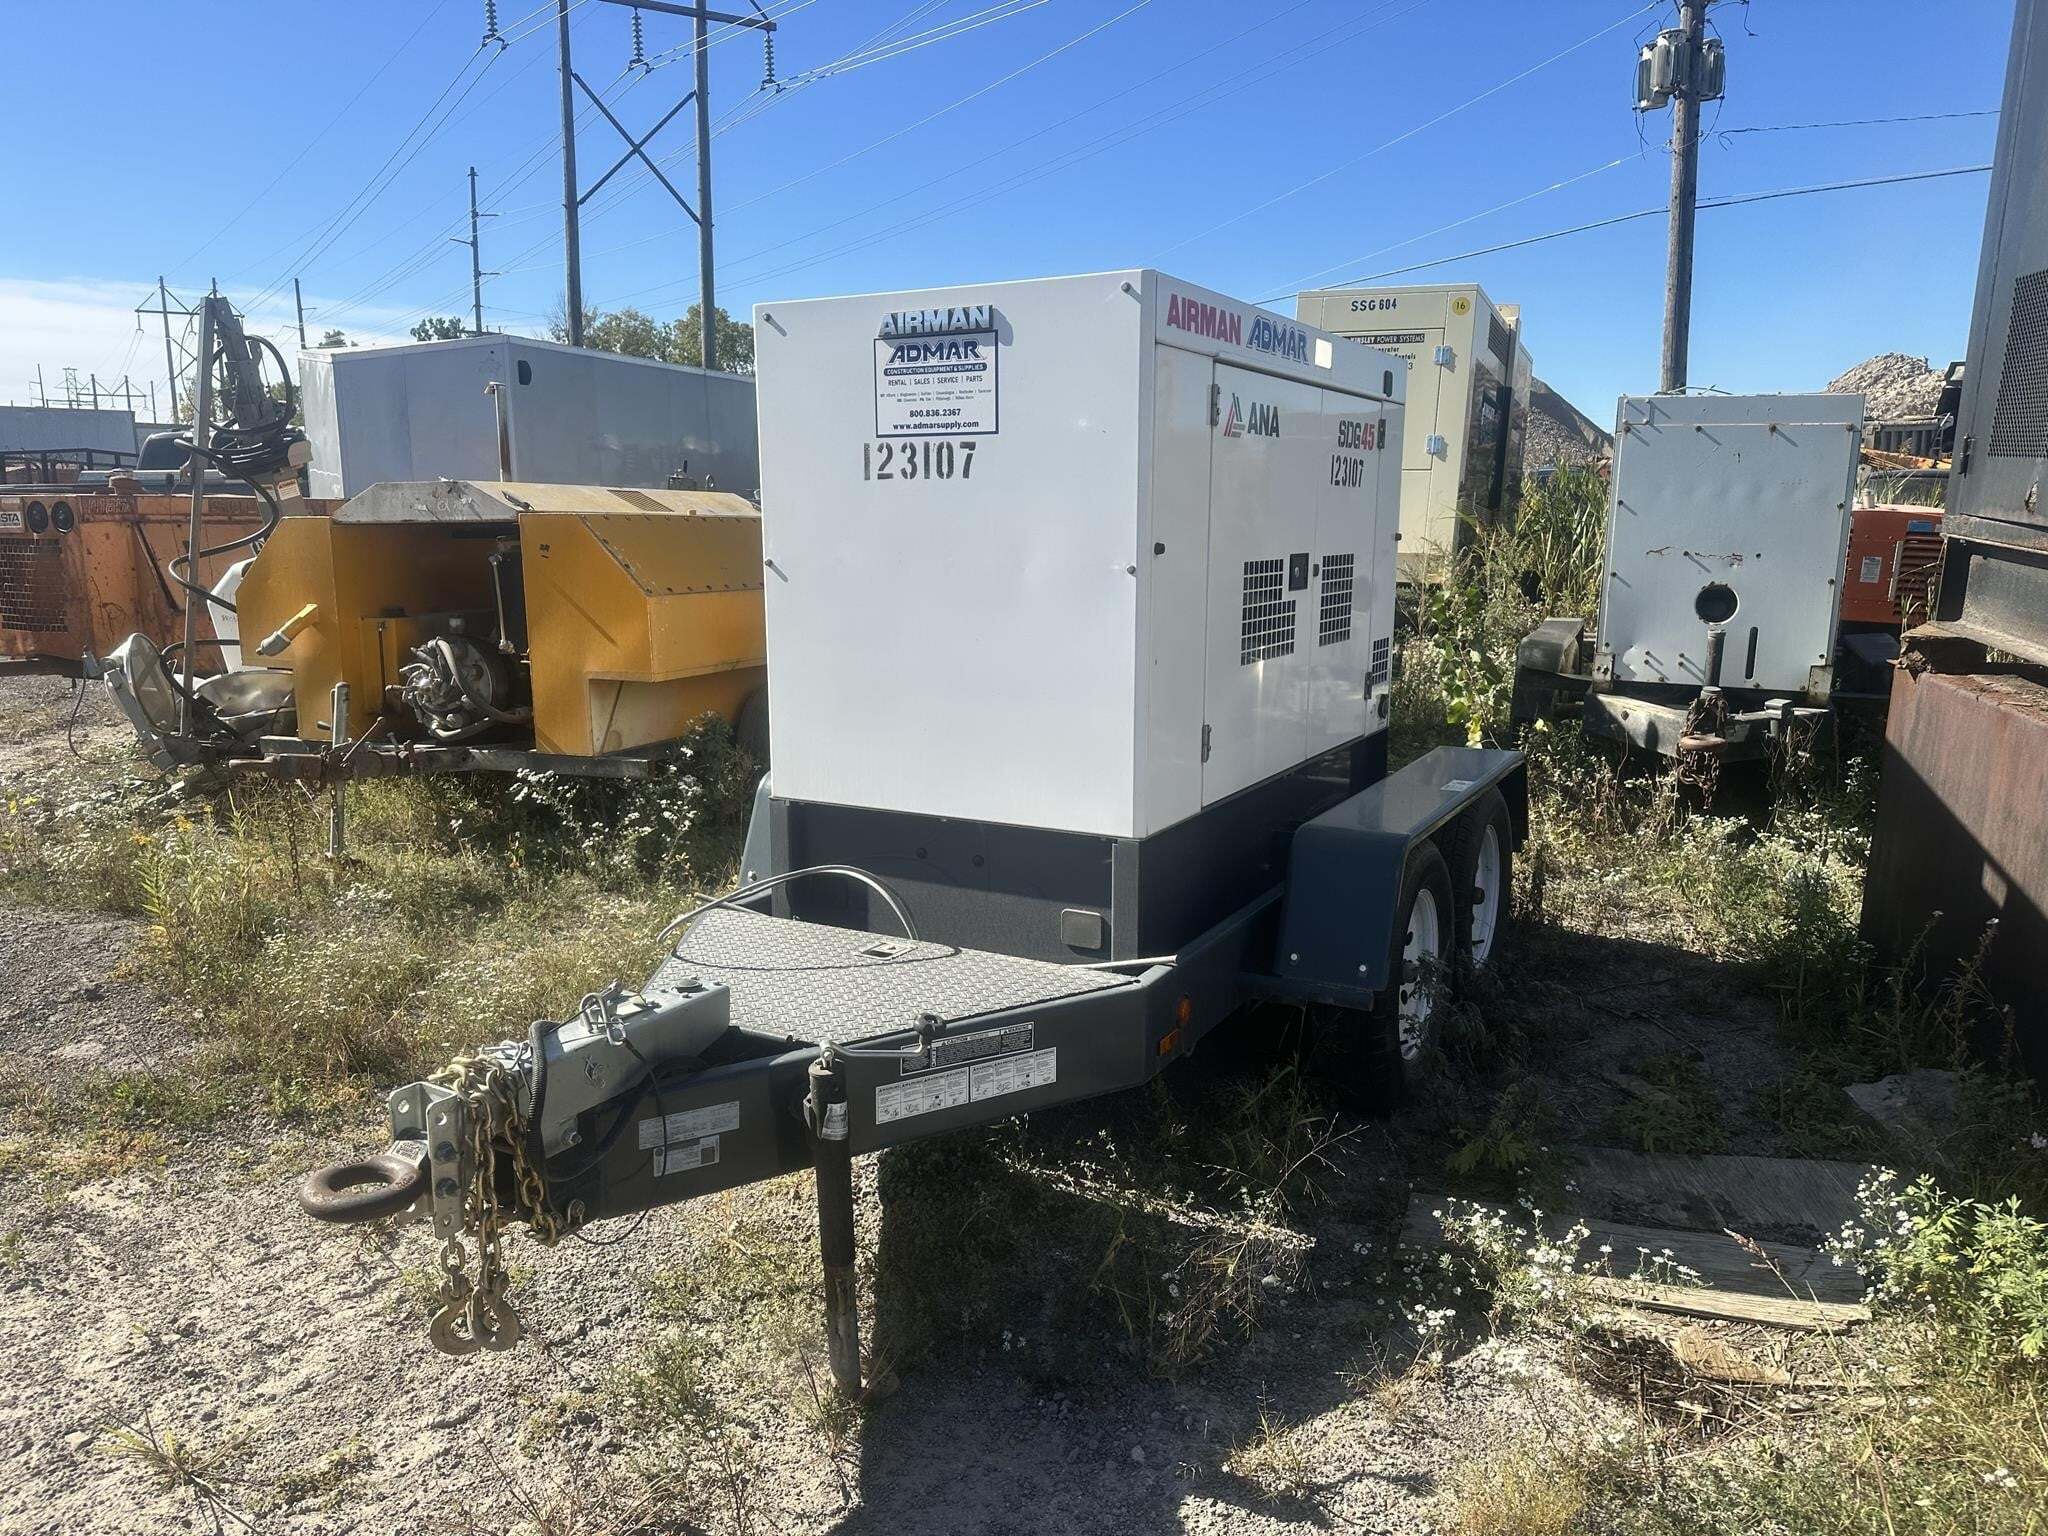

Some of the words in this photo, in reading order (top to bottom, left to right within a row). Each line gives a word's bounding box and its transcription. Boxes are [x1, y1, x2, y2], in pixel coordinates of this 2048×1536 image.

[1351, 300, 1376, 312] SSG
[1379, 298, 1397, 310] 604
[1455, 301, 1466, 310] 16
[879, 305, 992, 338] AIRMAN
[1167, 293, 1242, 346] AIRMAN
[1246, 315, 1310, 366] ADMAR
[1376, 335, 1397, 343] POWER
[1399, 334, 1425, 342] SYSTEMS
[887, 339, 985, 365] ADMAR
[887, 367, 924, 375] CONSTRUCTION
[925, 365, 953, 373] EQUIPMENT
[937, 376, 959, 384] SERVICE
[893, 421, 979, 431] www.admarsupply.com
[1247, 402, 1280, 438] ANA
[1338, 419, 1376, 451] SDG45
[864, 441, 977, 481] 123107
[1330, 454, 1365, 488] 123107
